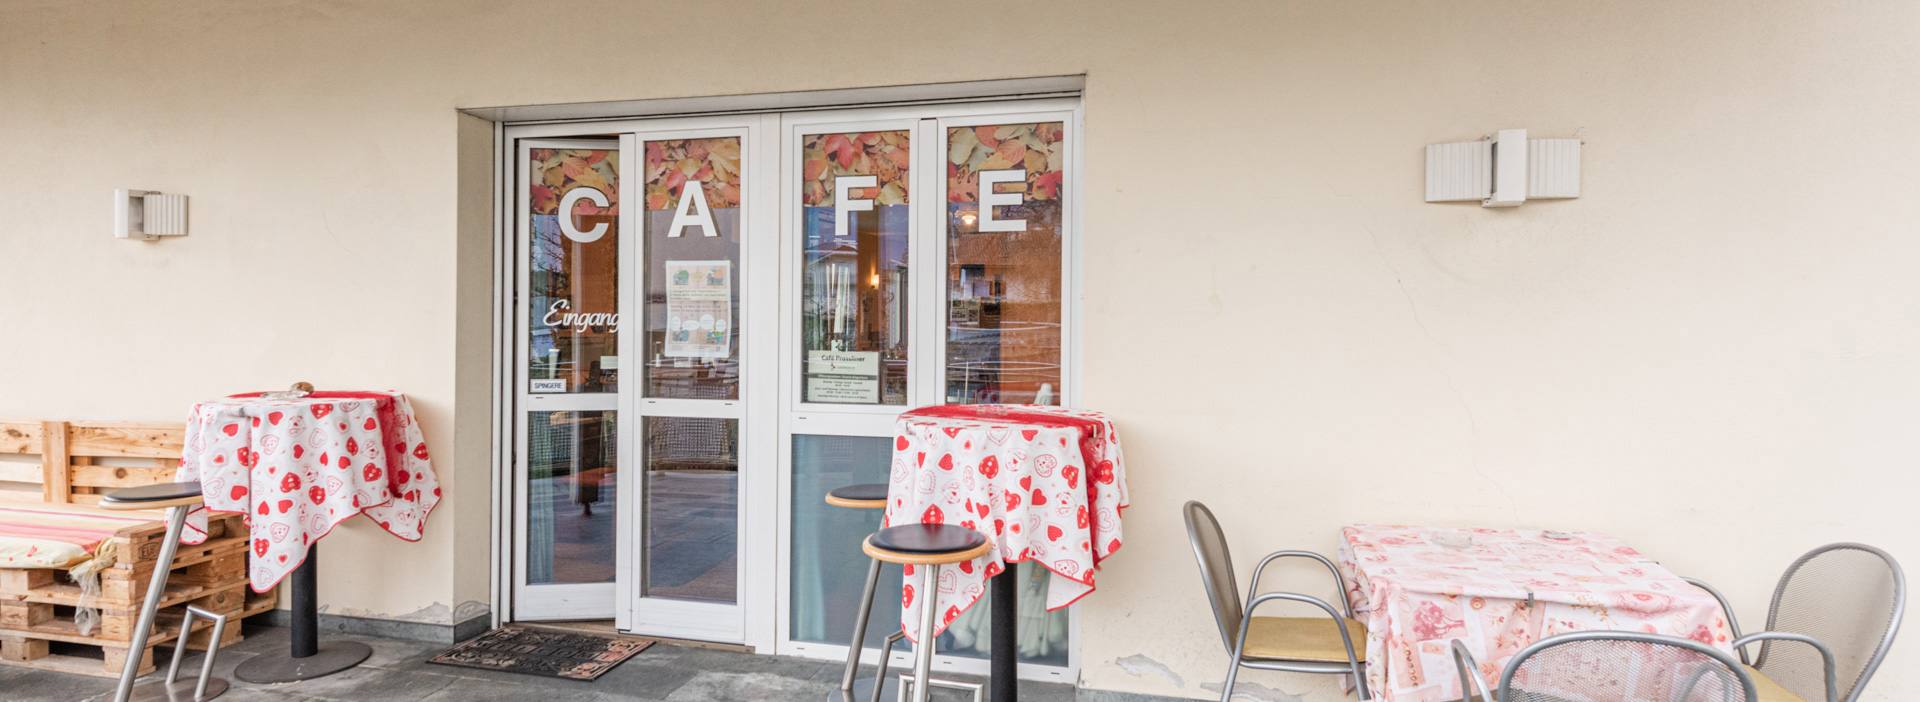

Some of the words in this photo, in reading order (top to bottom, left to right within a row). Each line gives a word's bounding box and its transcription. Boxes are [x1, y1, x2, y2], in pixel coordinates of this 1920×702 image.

[558, 169, 1027, 243] CAFE
[543, 299, 621, 334] Eingang
[534, 382, 563, 390] SPINGERE
